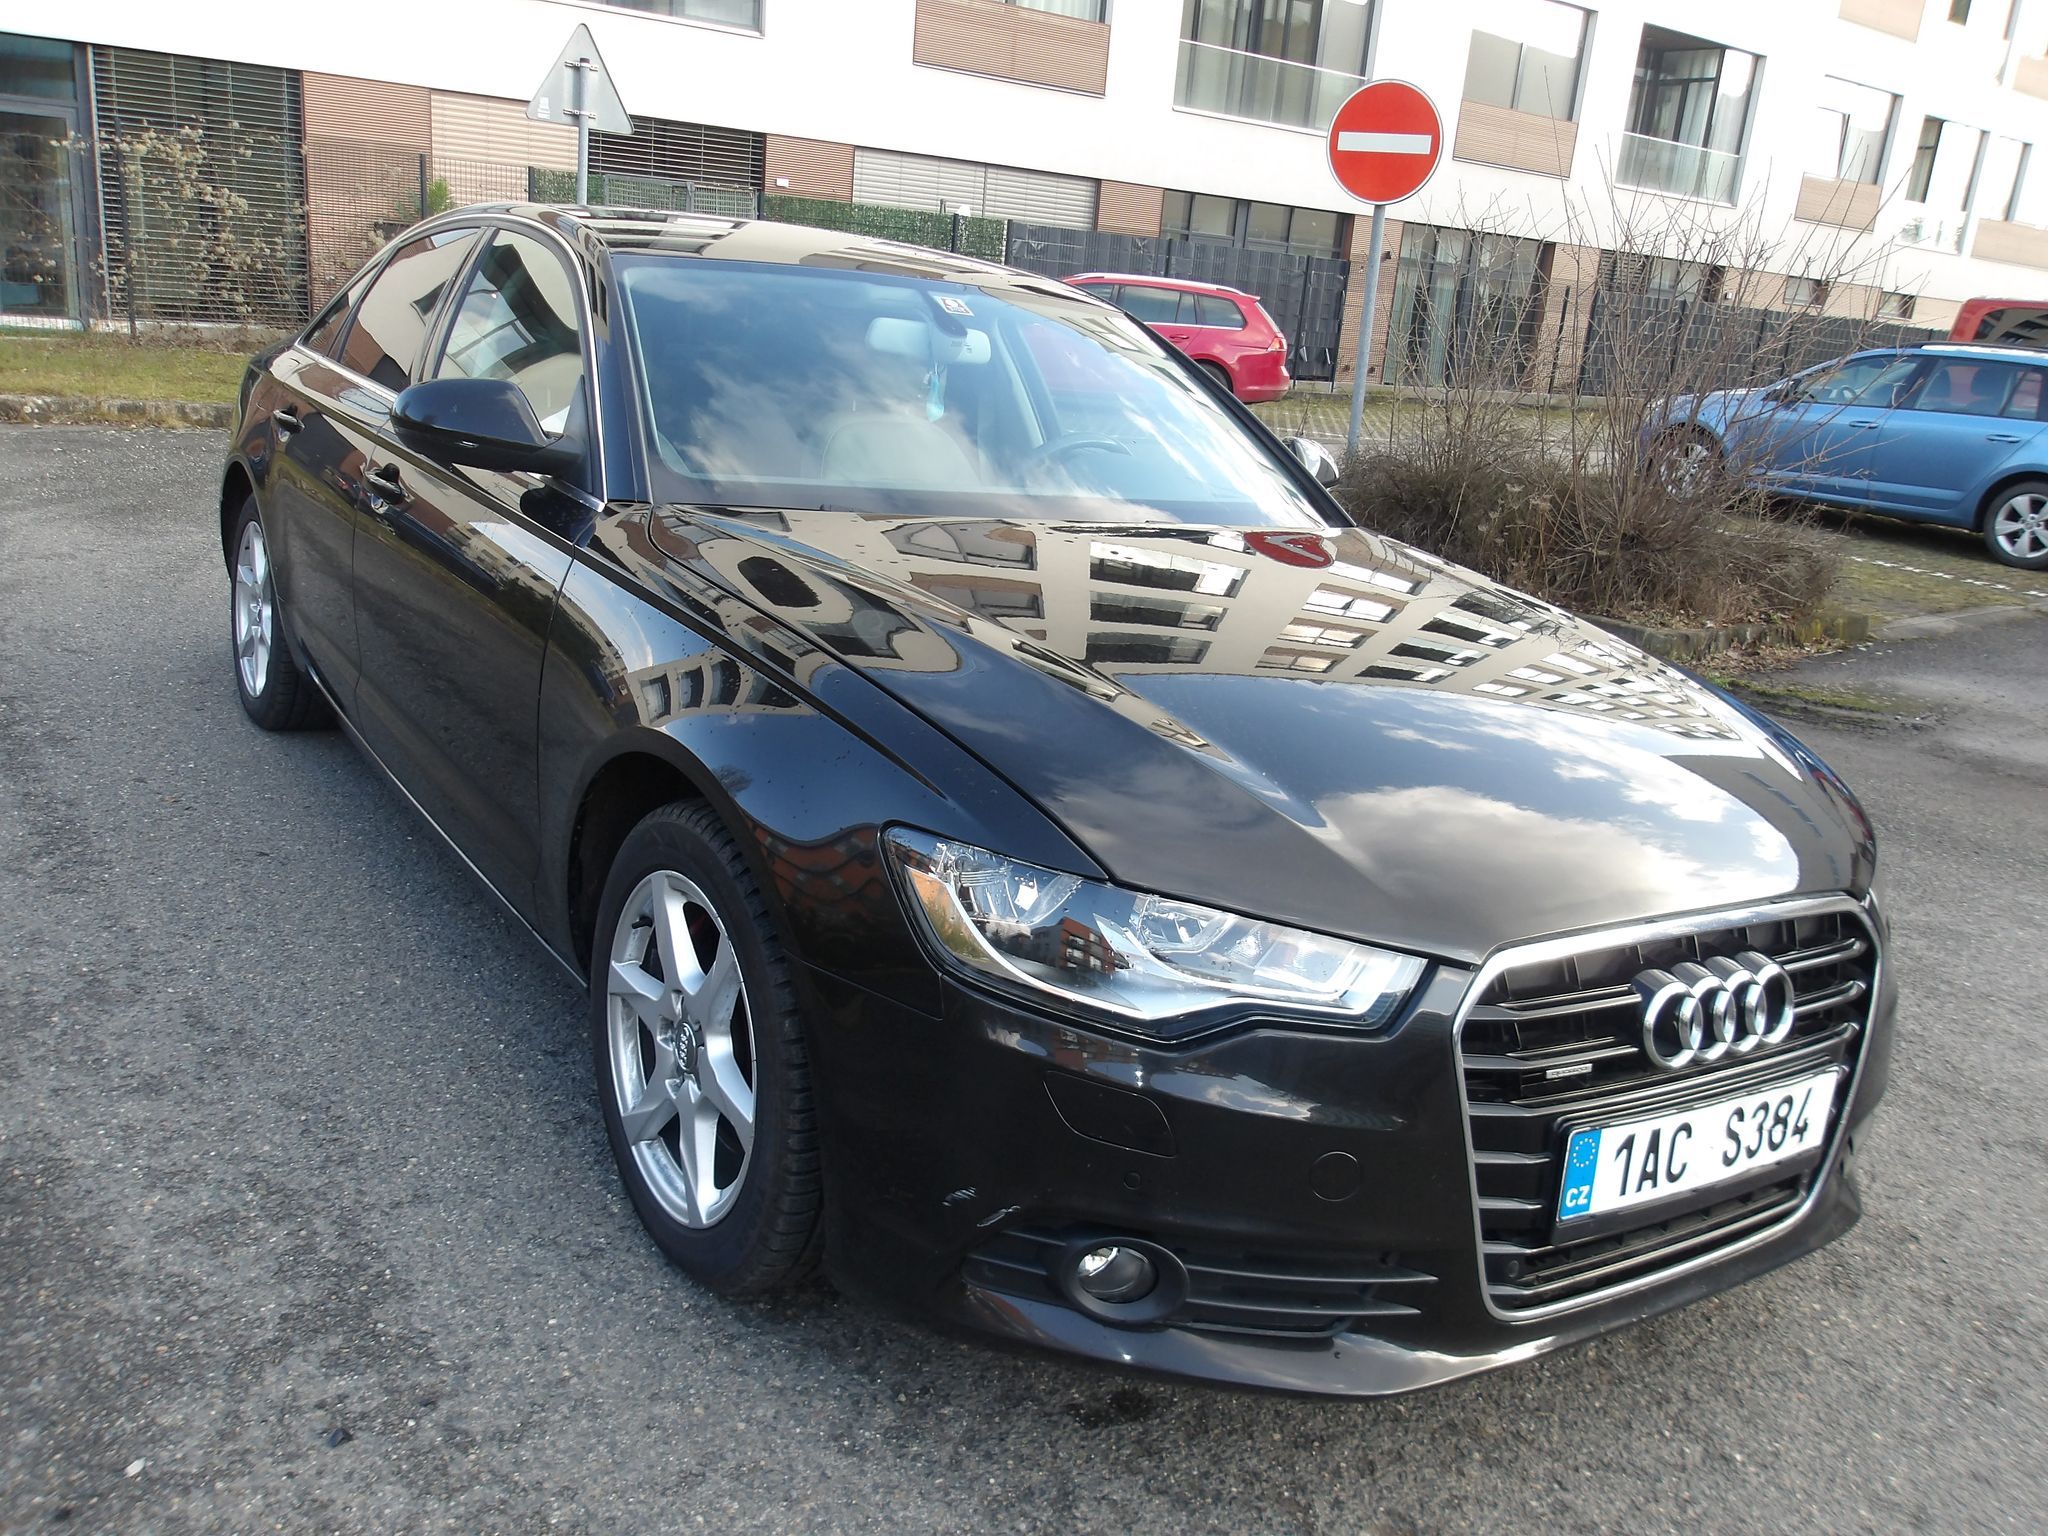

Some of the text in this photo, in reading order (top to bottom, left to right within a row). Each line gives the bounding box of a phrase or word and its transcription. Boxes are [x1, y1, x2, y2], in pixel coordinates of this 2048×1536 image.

[1614, 1087, 1813, 1197] 1AC S384
[1565, 1184, 1591, 1208] CZ
